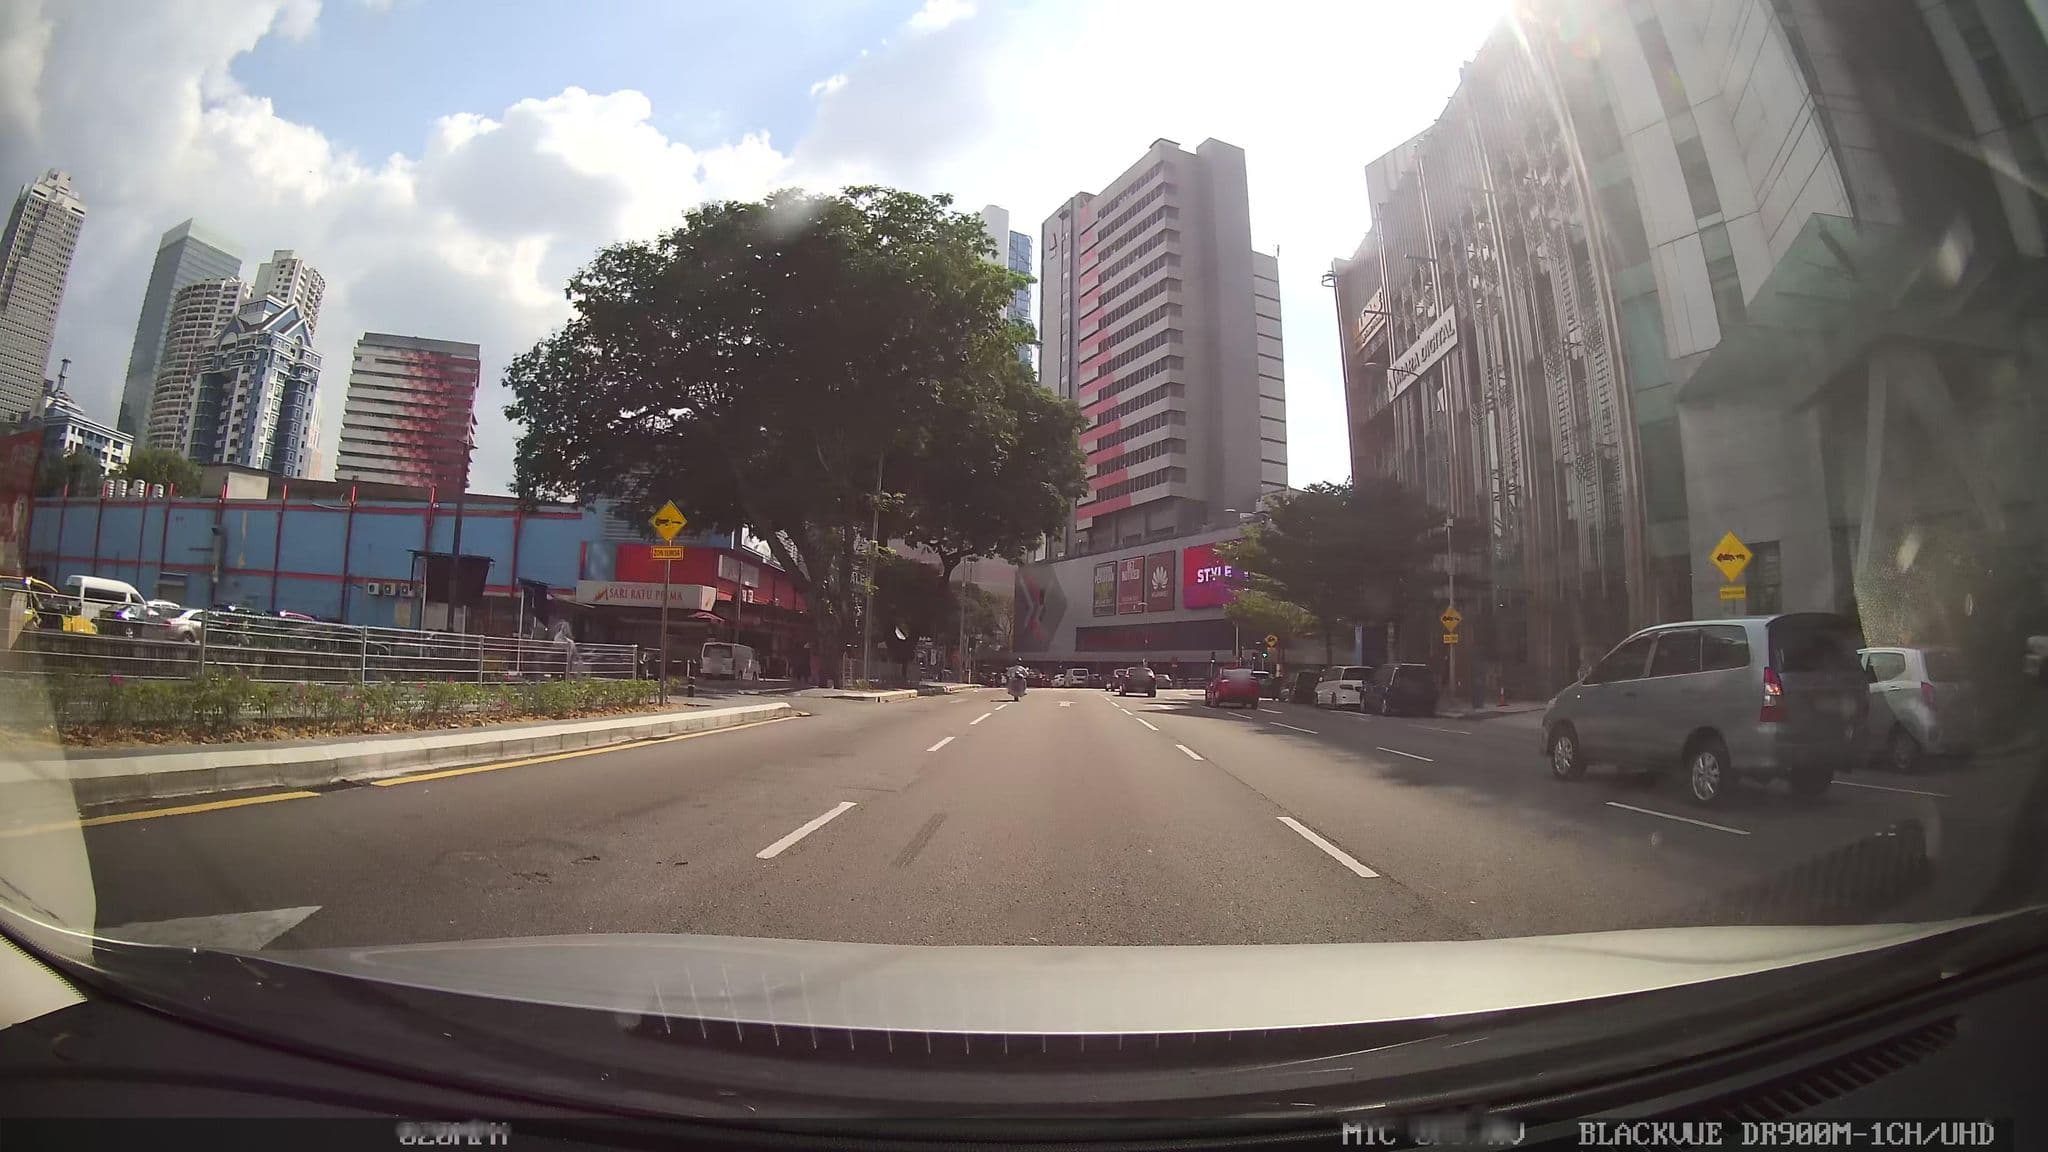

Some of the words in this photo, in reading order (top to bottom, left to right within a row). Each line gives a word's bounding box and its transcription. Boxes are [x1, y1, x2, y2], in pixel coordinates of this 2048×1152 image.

[1421, 319, 1455, 362] DIGITAL
[609, 588, 628, 599] SARI
[630, 589, 652, 600] RATU
[655, 590, 683, 601] PRMA
